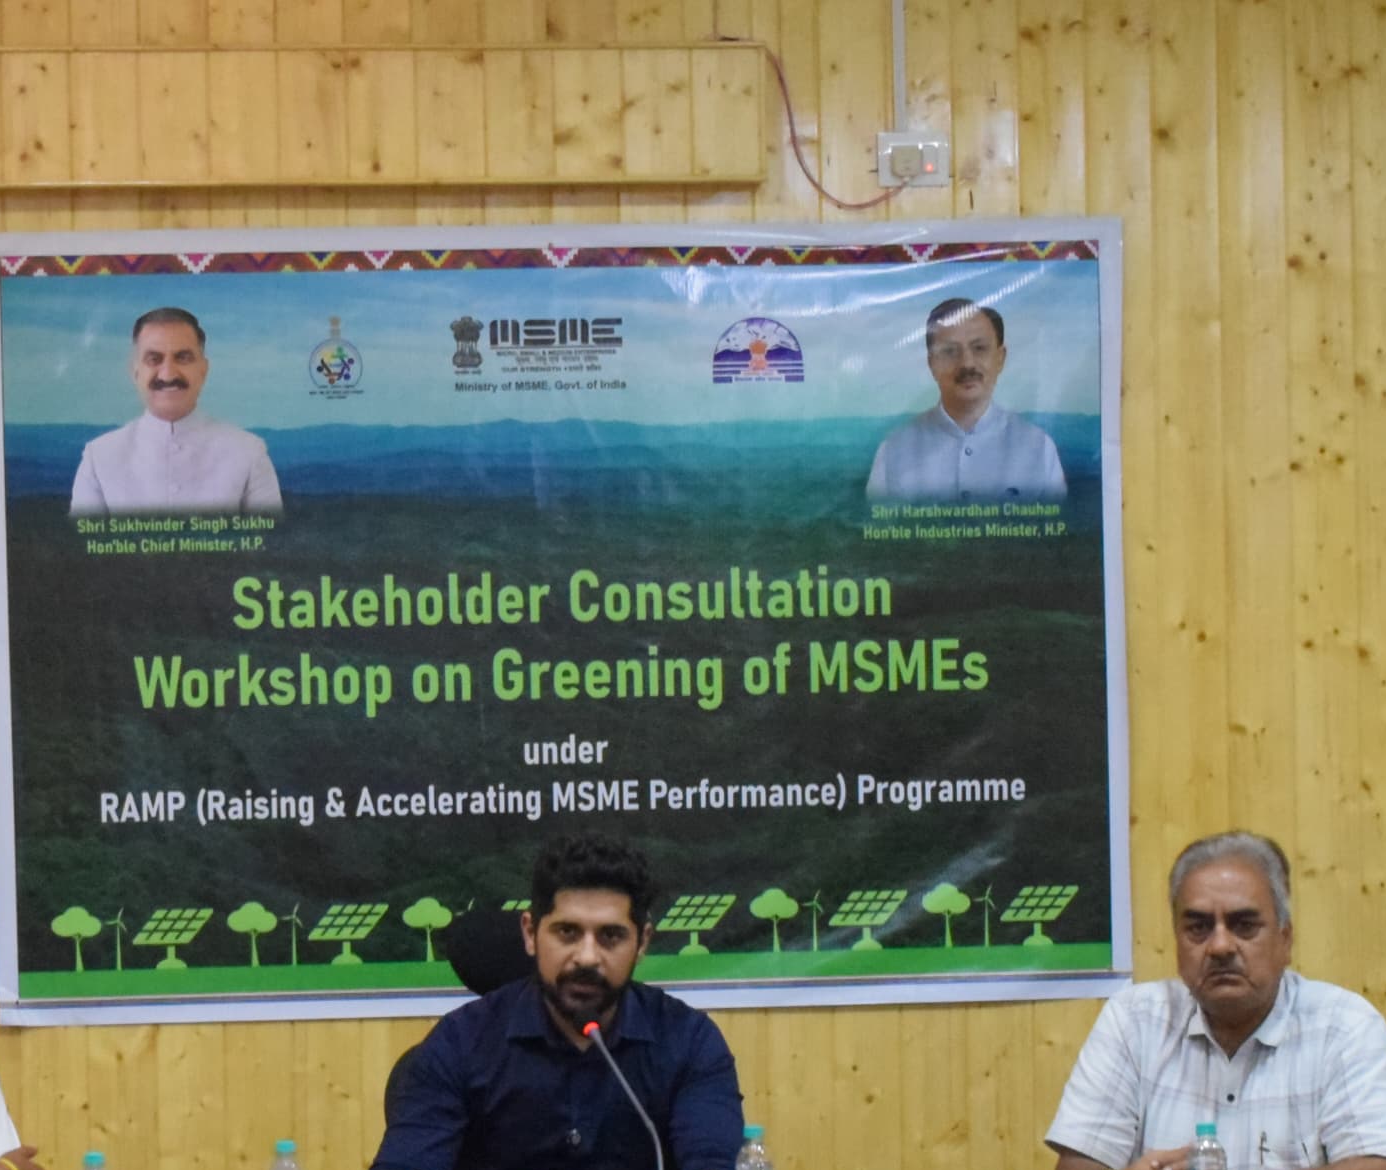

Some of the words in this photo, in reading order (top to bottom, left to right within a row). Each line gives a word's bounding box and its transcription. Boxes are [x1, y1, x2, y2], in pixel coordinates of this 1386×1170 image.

[489, 317, 623, 346] MSME
[454, 381, 498, 394] Ministry
[501, 381, 513, 392] of
[554, 380, 582, 392] Govt.
[585, 379, 598, 390] of
[599, 379, 627, 390] India
[871, 504, 899, 519] Shri
[902, 503, 999, 518] Harshwardhan
[1003, 501, 1061, 517] Chauhan
[77, 517, 105, 533] Shri
[109, 517, 185, 533] Sukhvinder
[189, 516, 228, 533] Singh
[232, 514, 275, 531] Sukhu
[915, 523, 982, 539] Industries
[985, 522, 1041, 538] Minister,
[1044, 521, 1068, 537] H.P.
[87, 538, 137, 554] Hon'ble
[140, 537, 176, 553] Chief
[179, 536, 237, 552] Minister,
[240, 535, 266, 551] H.P.
[232, 571, 551, 630] Stakeholder
[569, 565, 892, 623] Consultation
[133, 652, 392, 718] Workshop
[412, 662, 472, 703] on
[492, 644, 723, 710] Greening
[743, 642, 792, 695] of
[809, 637, 989, 694] MSMEs
[523, 733, 609, 765] under
[100, 790, 186, 824] RAMP
[196, 788, 314, 827] (Raising
[324, 786, 346, 818] &
[355, 783, 541, 820] Accelerating
[552, 779, 640, 812] MSME
[649, 773, 847, 810] Performance)
[856, 773, 1027, 811] Programme
